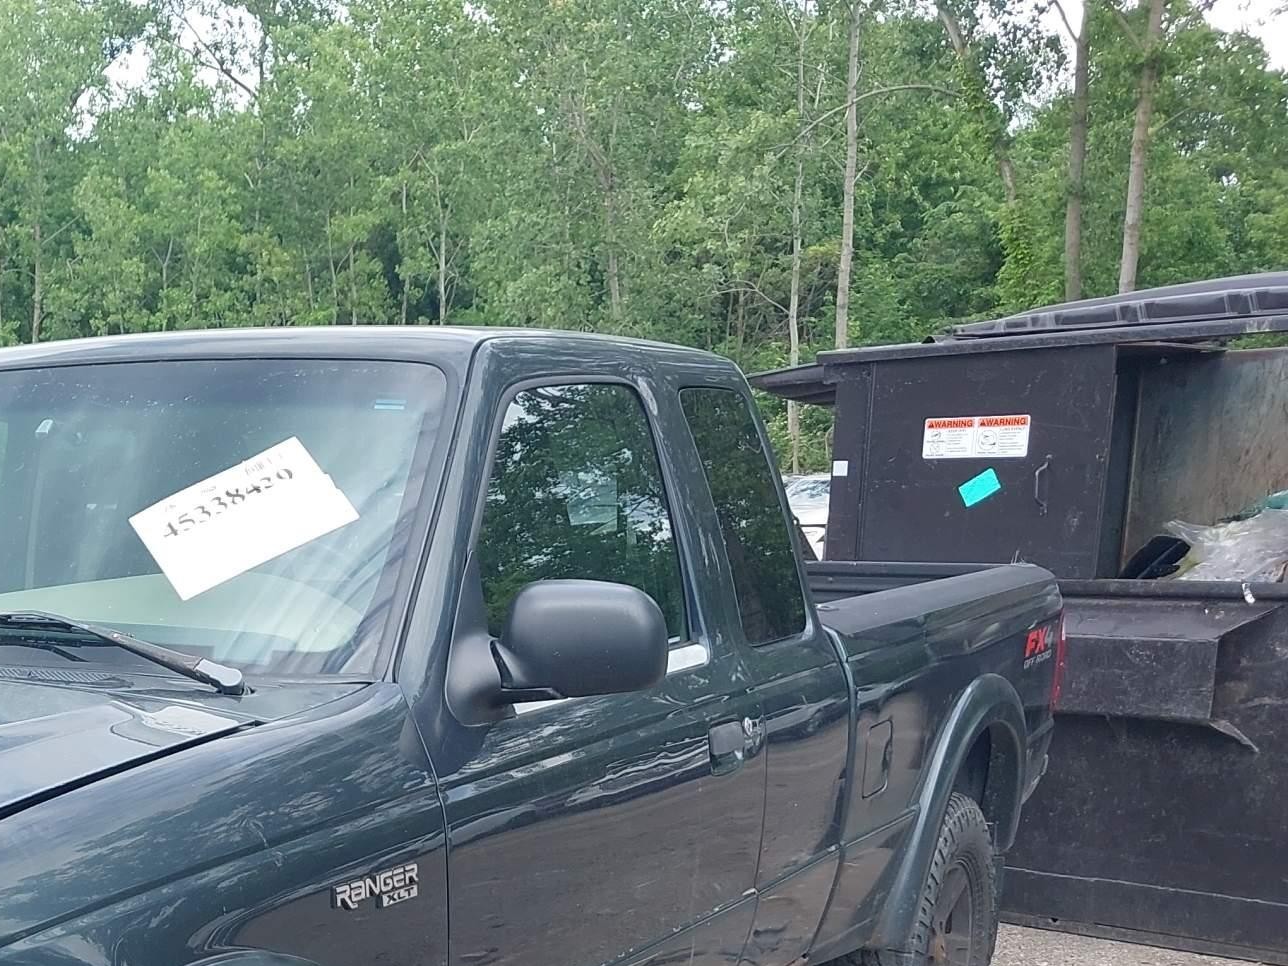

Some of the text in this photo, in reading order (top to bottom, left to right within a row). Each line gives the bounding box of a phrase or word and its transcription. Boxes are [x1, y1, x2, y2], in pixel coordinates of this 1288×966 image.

[933, 418, 974, 429] WARNING
[984, 416, 1026, 428] WARNING
[1024, 625, 1053, 658] FX4
[335, 863, 419, 909] RANGER
[385, 886, 417, 906] XLT
